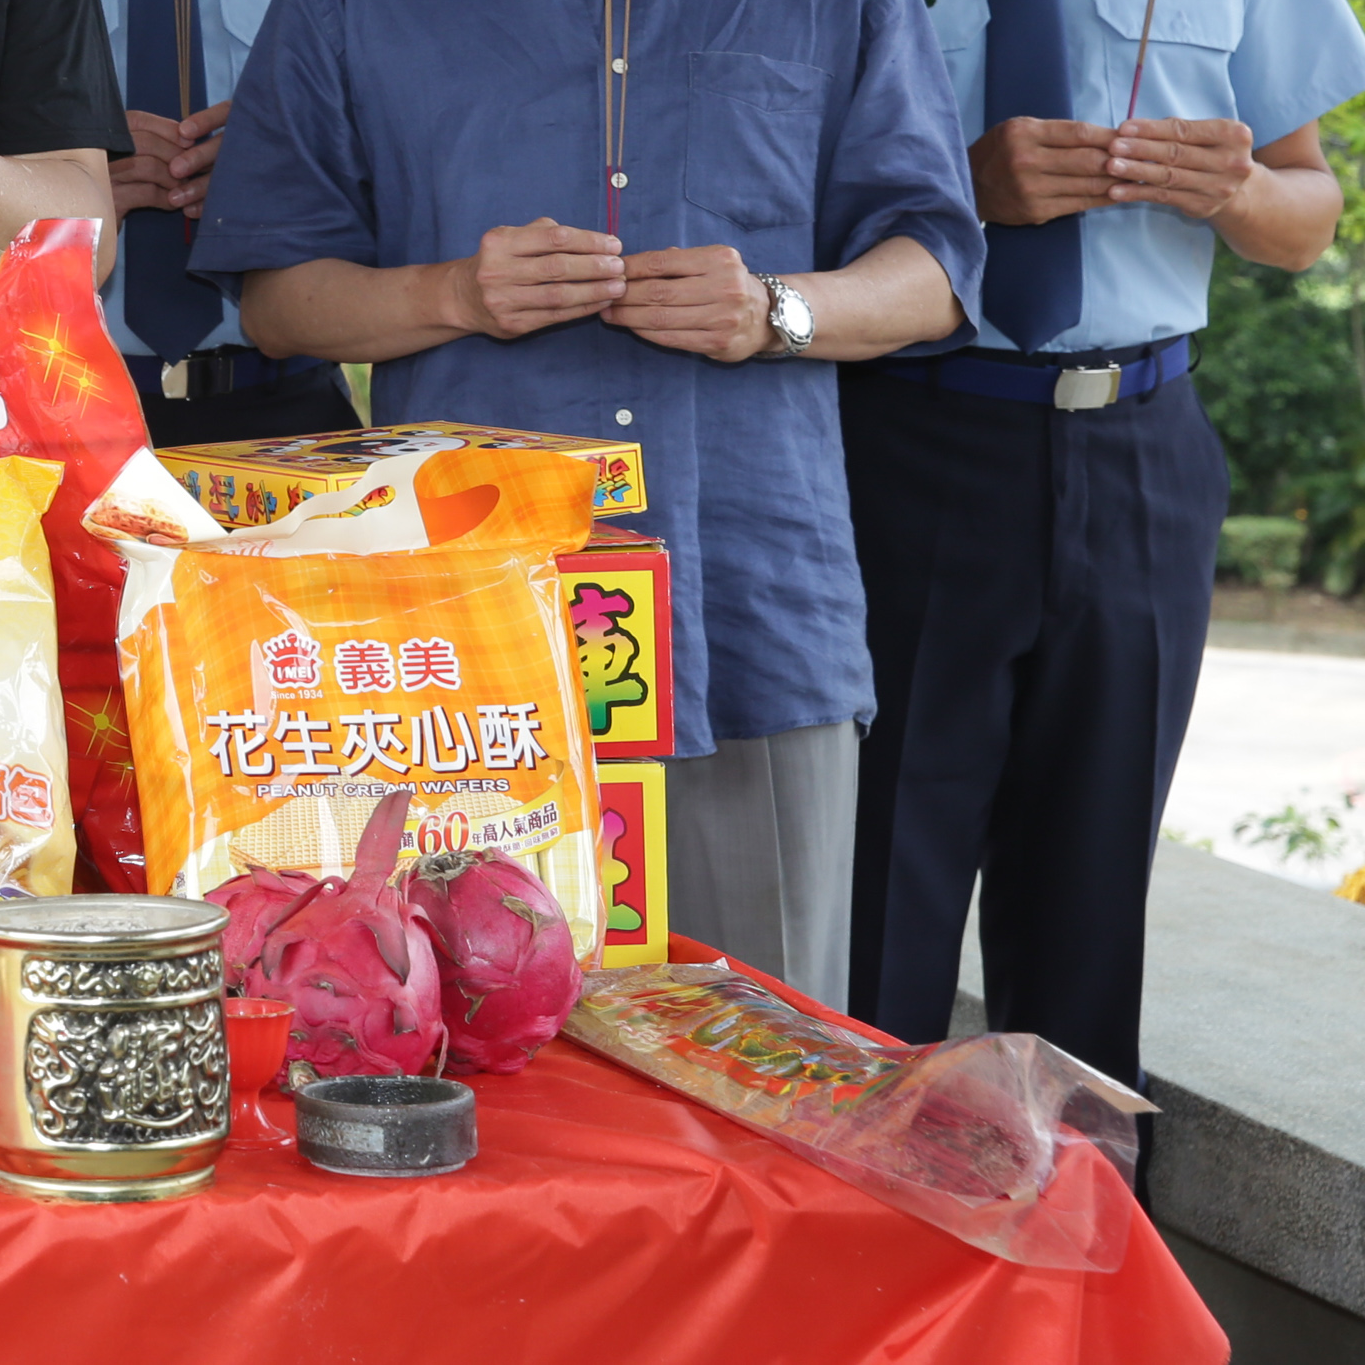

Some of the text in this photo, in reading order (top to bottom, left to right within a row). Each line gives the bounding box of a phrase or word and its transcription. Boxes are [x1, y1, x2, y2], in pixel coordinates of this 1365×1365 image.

[335, 639, 459, 692] 義美
[271, 689, 324, 700] Since 1934
[206, 701, 550, 777] 花生夾心酥
[256, 777, 511, 799] PEANUT CREAM WAFERS
